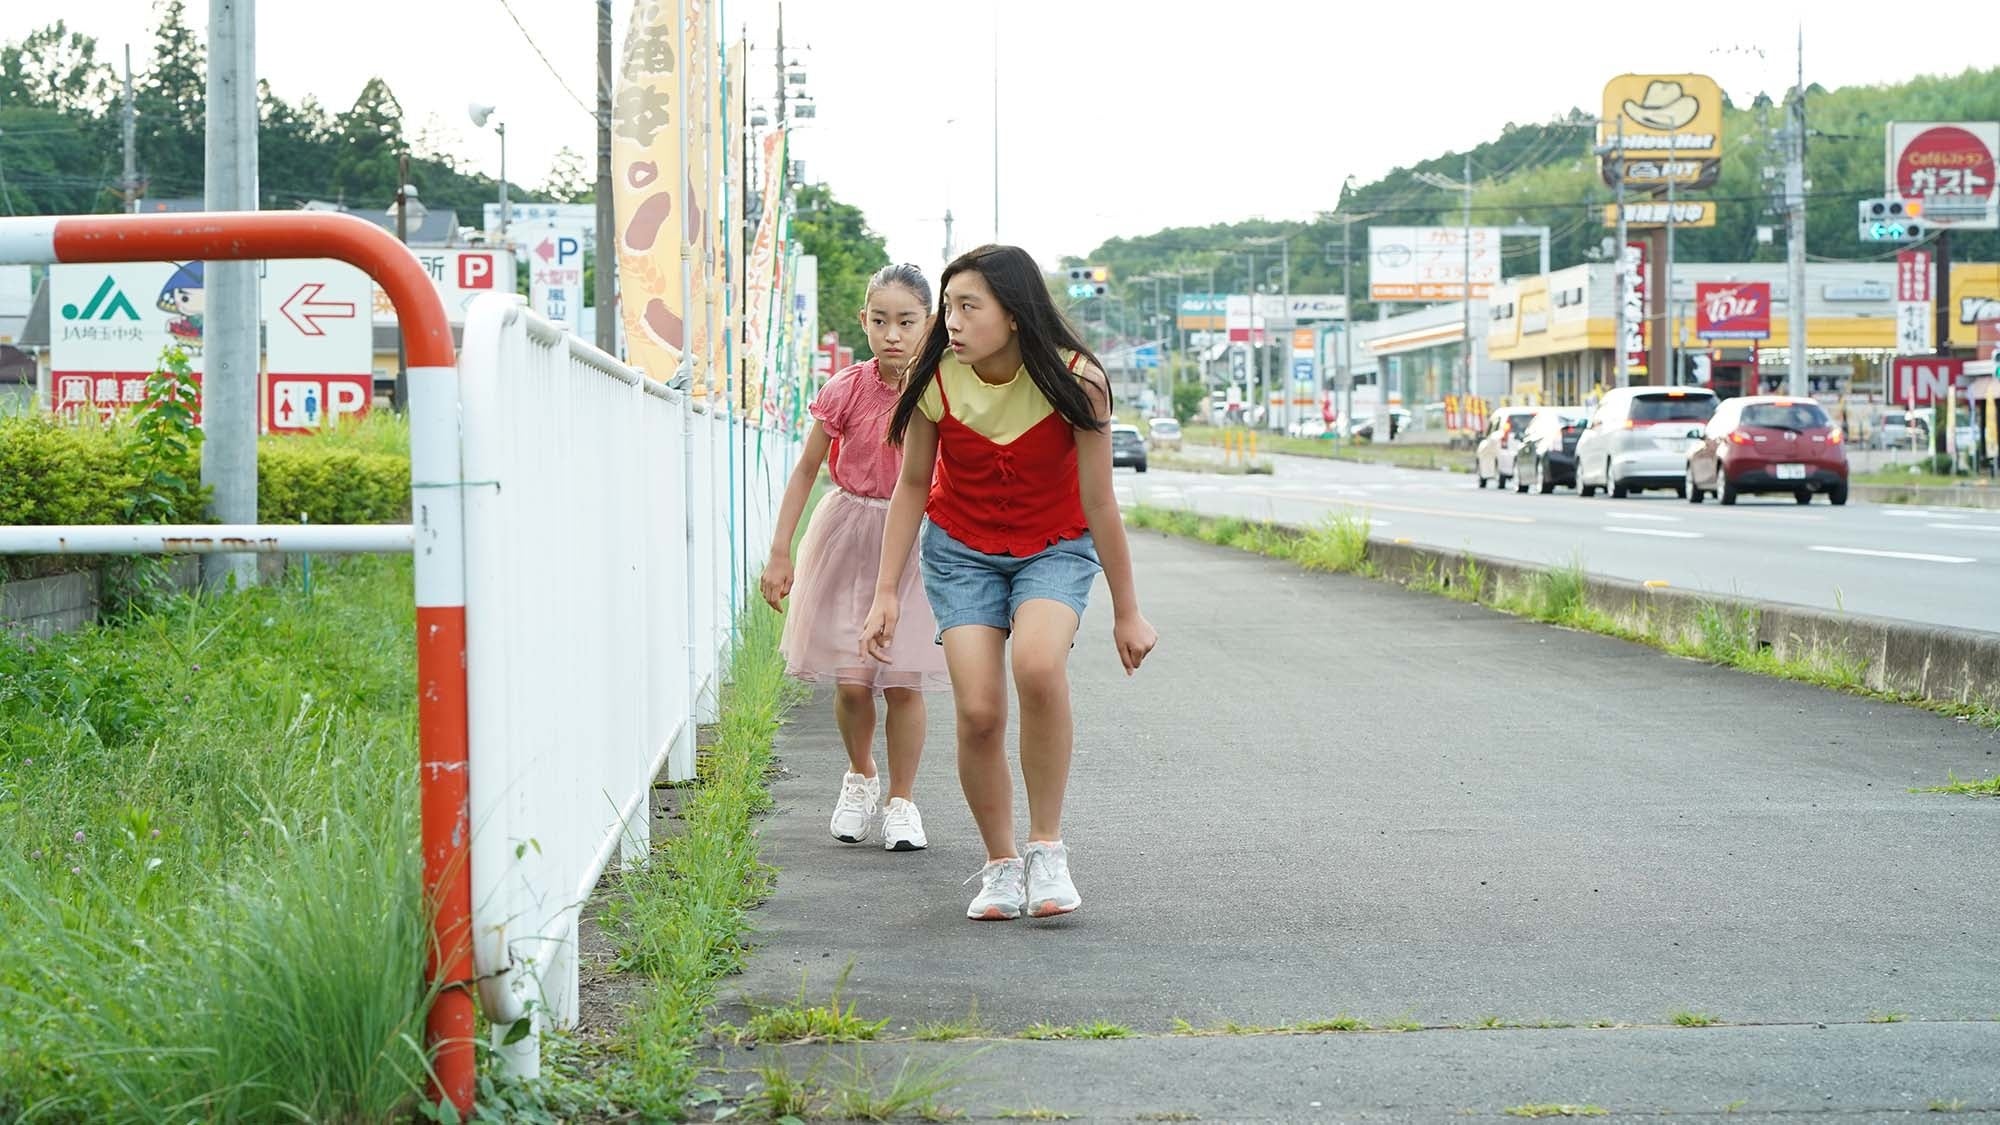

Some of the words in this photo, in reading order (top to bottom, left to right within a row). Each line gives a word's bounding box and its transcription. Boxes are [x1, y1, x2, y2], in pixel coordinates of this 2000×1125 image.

[1910, 167, 1987, 195] ガスト
[558, 237, 578, 265] P
[464, 256, 489, 287] P
[63, 326, 143, 341] JA埼玉中央
[327, 381, 366, 429] P
